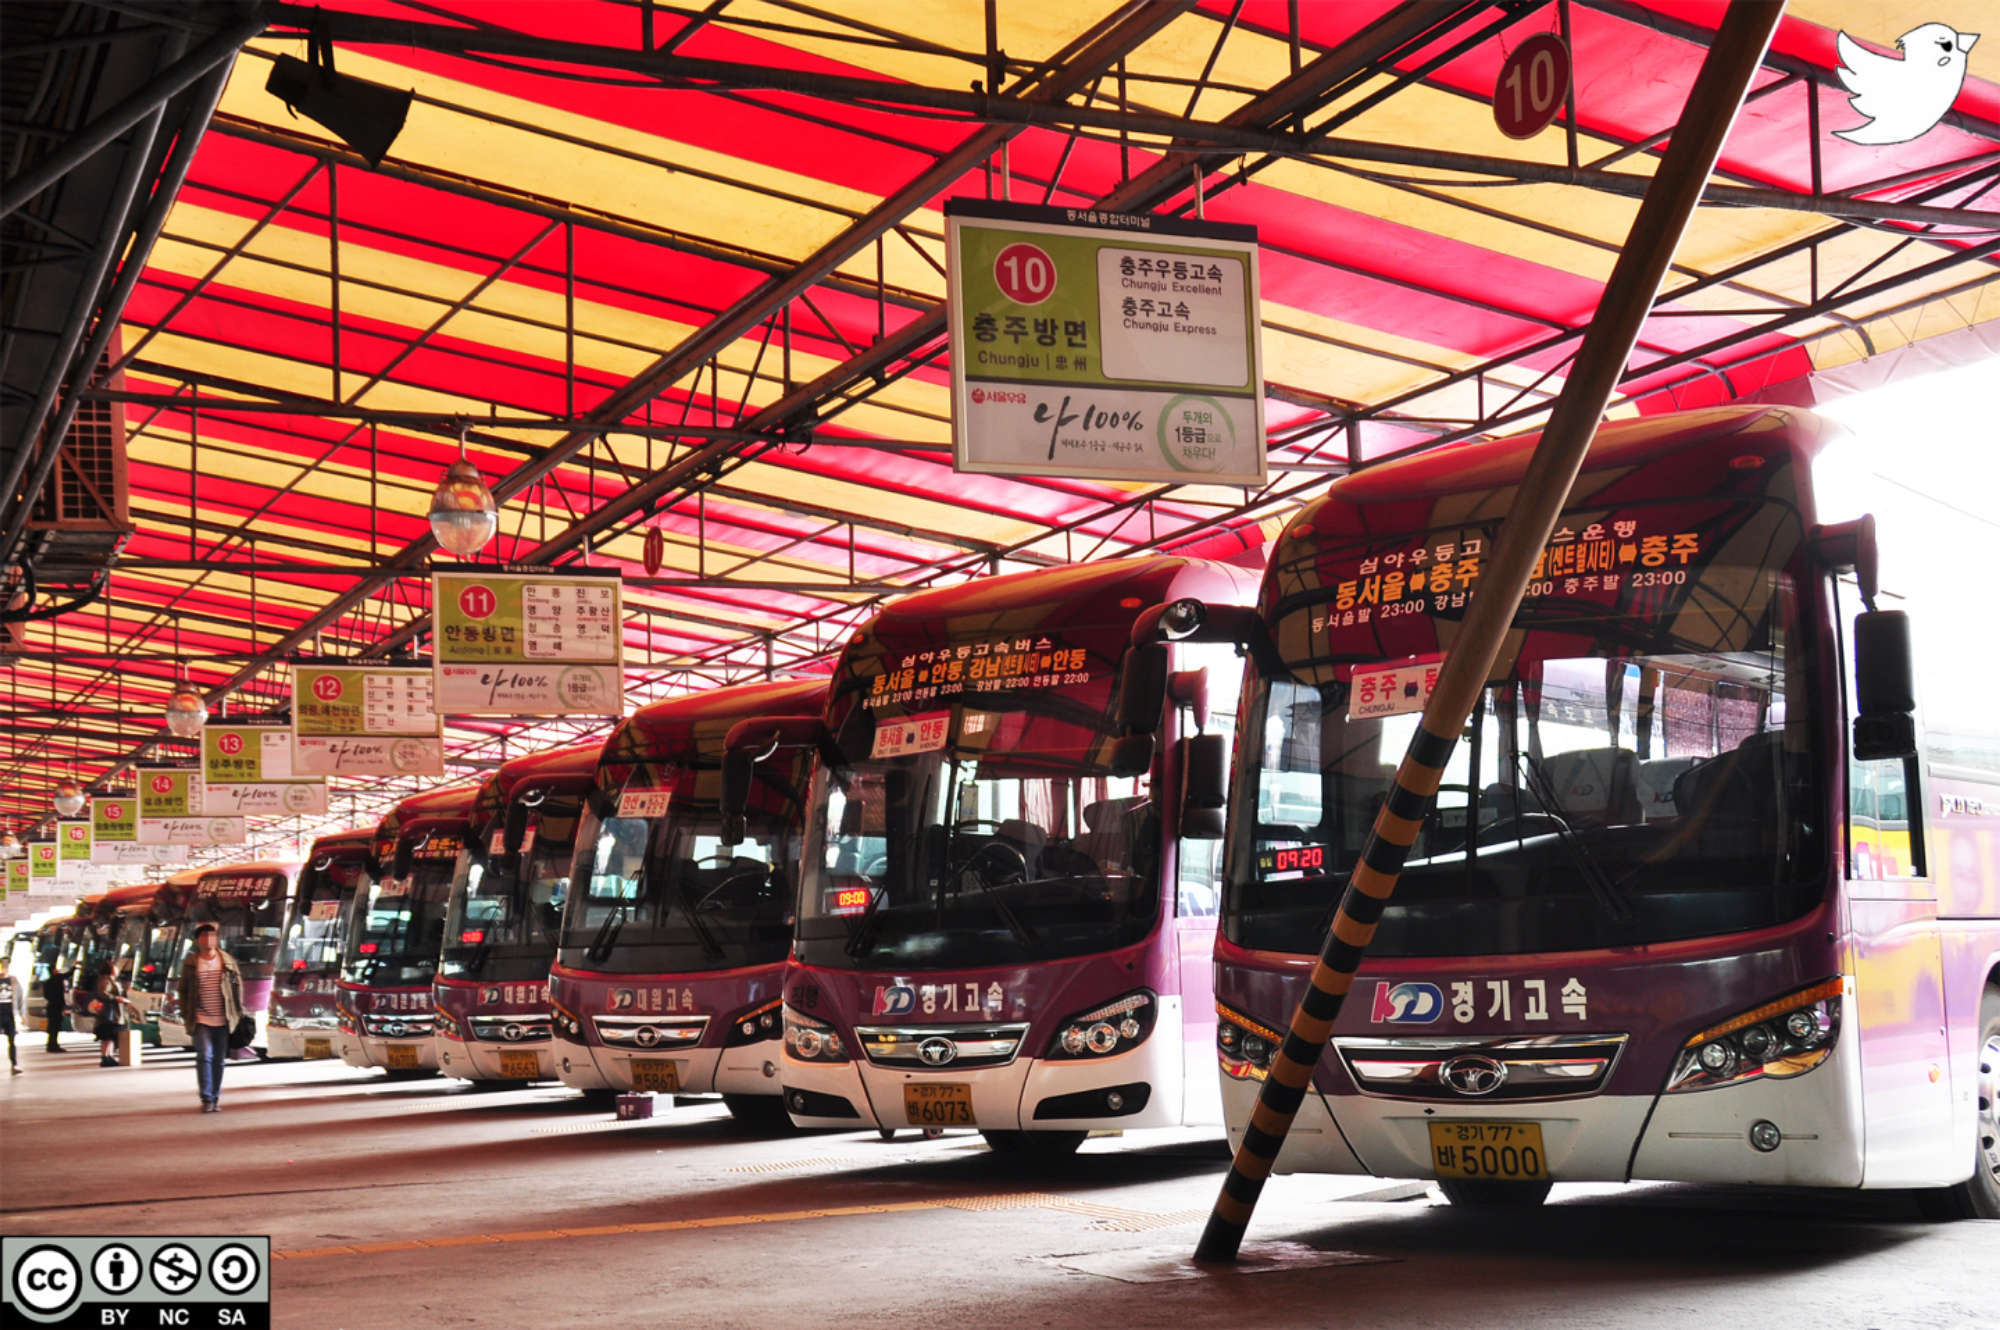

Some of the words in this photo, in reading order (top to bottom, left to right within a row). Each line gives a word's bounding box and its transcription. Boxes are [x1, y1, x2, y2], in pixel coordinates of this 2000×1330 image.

[1505, 49, 1555, 122] 10
[1066, 209, 1151, 229] 동서울종합터미널
[1002, 255, 1047, 294] 10
[1120, 256, 1223, 283] 충주우등고속
[1121, 278, 1167, 293] Chungju
[1172, 281, 1222, 296] Excellent
[1122, 296, 1191, 320] 충주고속
[972, 312, 1087, 348] 충주방면
[1123, 318, 1169, 334] Chungju
[1174, 322, 1217, 336] Express
[977, 350, 1040, 369] Chungju
[1336, 571, 1405, 611] 동서울
[1430, 557, 1480, 593] 충주
[1640, 533, 1699, 567] 충주
[464, 591, 489, 613] 11
[1312, 607, 1372, 633] 동서울발
[1380, 599, 1425, 619] 23:00
[1434, 591, 1475, 611] 강남
[1564, 574, 1620, 595] 충주발
[1632, 570, 1686, 588] 23:00
[445, 625, 516, 643] 안동방면
[872, 668, 915, 695] 동서울
[1053, 649, 1087, 671] 안동
[317, 680, 338, 697] 12
[1360, 674, 1398, 704] 충주
[920, 720, 944, 742] 안동
[223, 737, 240, 751] 13
[155, 779, 170, 790] 14
[106, 807, 120, 817] 15
[839, 891, 865, 906] 09:00
[637, 987, 693, 1011] 대원고속
[921, 981, 1004, 1015] 경기고속
[1451, 977, 1588, 1024] 경기고속
